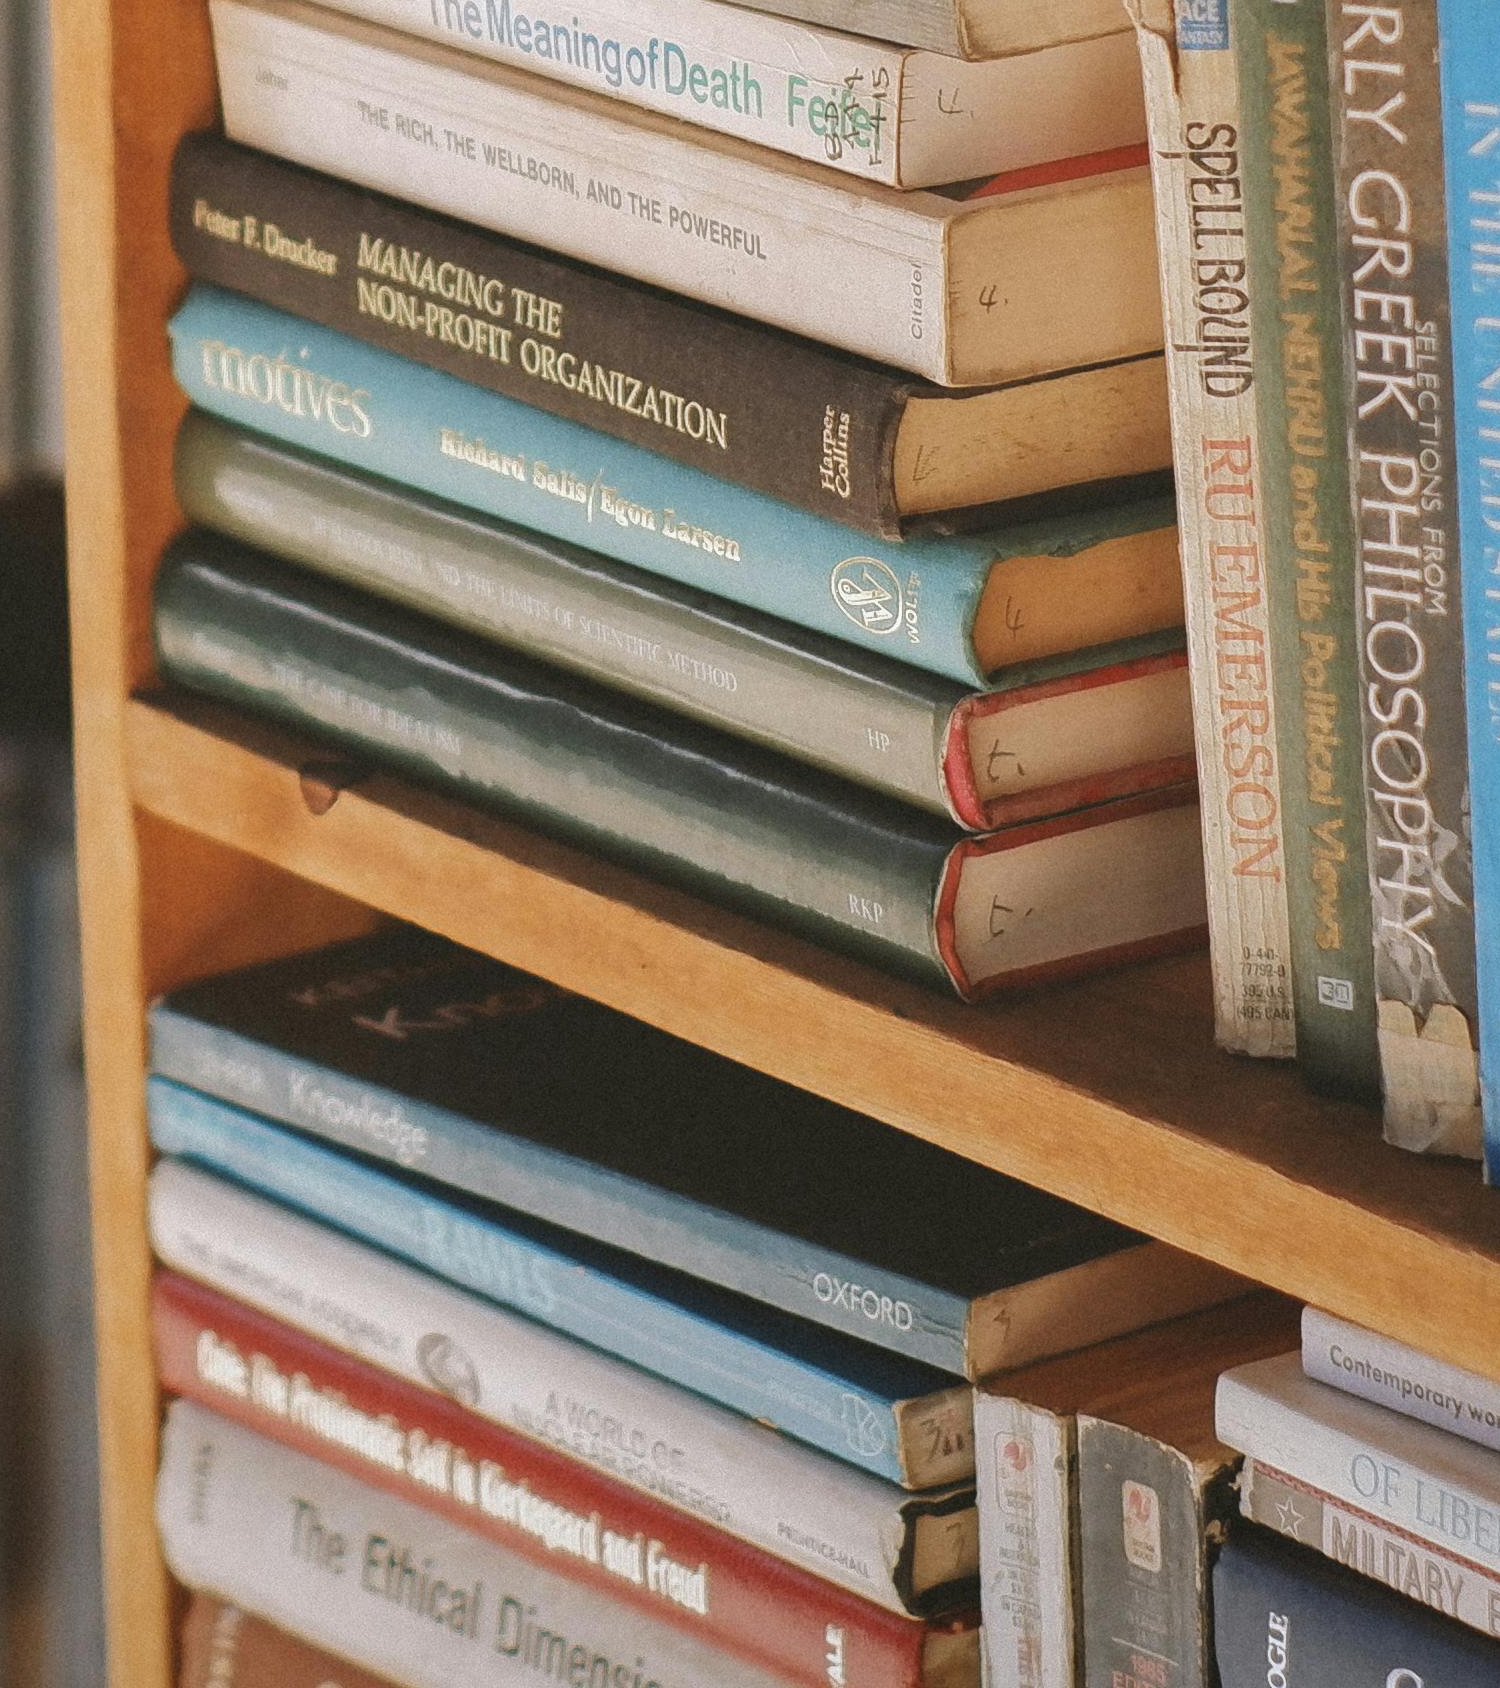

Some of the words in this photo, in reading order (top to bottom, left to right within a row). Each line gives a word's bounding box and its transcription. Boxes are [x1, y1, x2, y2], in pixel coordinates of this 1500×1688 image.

[624, 38, 658, 88] of
[663, 42, 763, 118] Death
[356, 99, 389, 132] THE
[395, 112, 439, 149] RICH,
[444, 127, 476, 161] THE
[482, 145, 580, 200] WELLBORN,
[587, 179, 622, 211] AND
[627, 190, 662, 224] THE
[669, 209, 768, 261] POWERFUL
[1267, 31, 1318, 300] JAWAHARLAL
[244, 215, 261, 249] F.
[264, 224, 337, 275] Drucker
[357, 233, 503, 316] MANAGING
[511, 288, 562, 339] THE
[911, 262, 923, 340] Citadel
[1348, 169, 1417, 424] GREEK
[200, 339, 372, 440] motives
[357, 276, 511, 365] NON-PROFIT
[521, 338, 728, 450] ORGANIZATION
[1283, 312, 1328, 458] NEHRU
[819, 404, 835, 492] Harper
[835, 411, 851, 499] Collins
[1414, 319, 1443, 512] SELECTIONS
[440, 428, 526, 482] Richard
[662, 508, 741, 562] Larsen
[1202, 435, 1255, 526] RU
[1290, 465, 1329, 551] and
[1297, 552, 1330, 620] His
[1424, 526, 1448, 616] FROM
[579, 615, 663, 665] SCIENTIFIC
[668, 648, 738, 693] METHOD
[866, 726, 893, 753] HP
[1209, 543, 1282, 883] EMERSON
[1300, 631, 1341, 808] Political
[1359, 451, 1437, 957] PHILOSOPHY
[847, 893, 884, 924] RKP
[1309, 818, 1346, 950] Views
[289, 1069, 429, 1164] Knowledge
[813, 1272, 914, 1332] OXFORD
[1329, 1344, 1464, 1420] Contemporary
[1351, 1453, 1402, 1507] OF
[290, 1496, 347, 1576] The
[361, 1533, 482, 1639] Ethical
[647, 1539, 709, 1616] Freud
[1331, 1515, 1466, 1619] MILITARY
